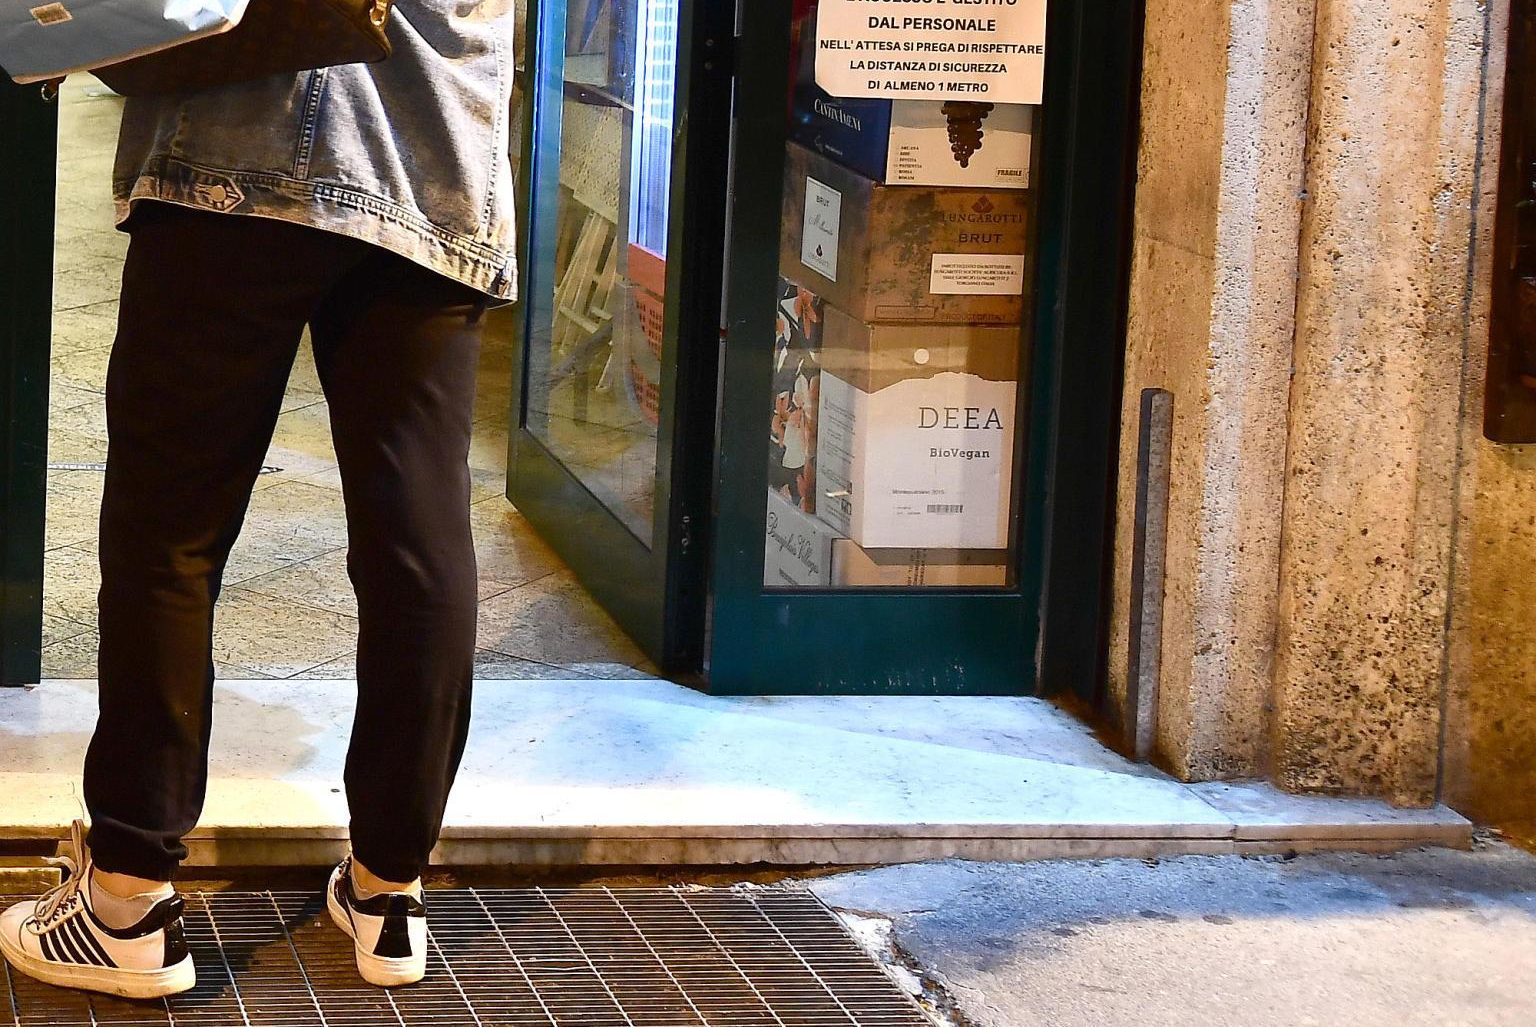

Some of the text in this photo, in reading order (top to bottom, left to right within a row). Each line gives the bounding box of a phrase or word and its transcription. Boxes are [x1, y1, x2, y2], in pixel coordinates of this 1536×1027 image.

[869, 17, 996, 31] DAL PERSONALE
[820, 40, 1043, 54] NELL' ATTESA SI PREGA DI RISPETTARE
[850, 61, 1007, 73] LA DISTANZA DI SICUREZZA
[868, 81, 988, 92] DI ALMENO 1 METRO
[997, 169, 1022, 177] FRAGILE
[941, 213, 1023, 223] LUNGAROTTI
[959, 233, 1003, 243] BRUT
[918, 407, 1004, 430] DEEA
[930, 448, 990, 460] BioVegan
